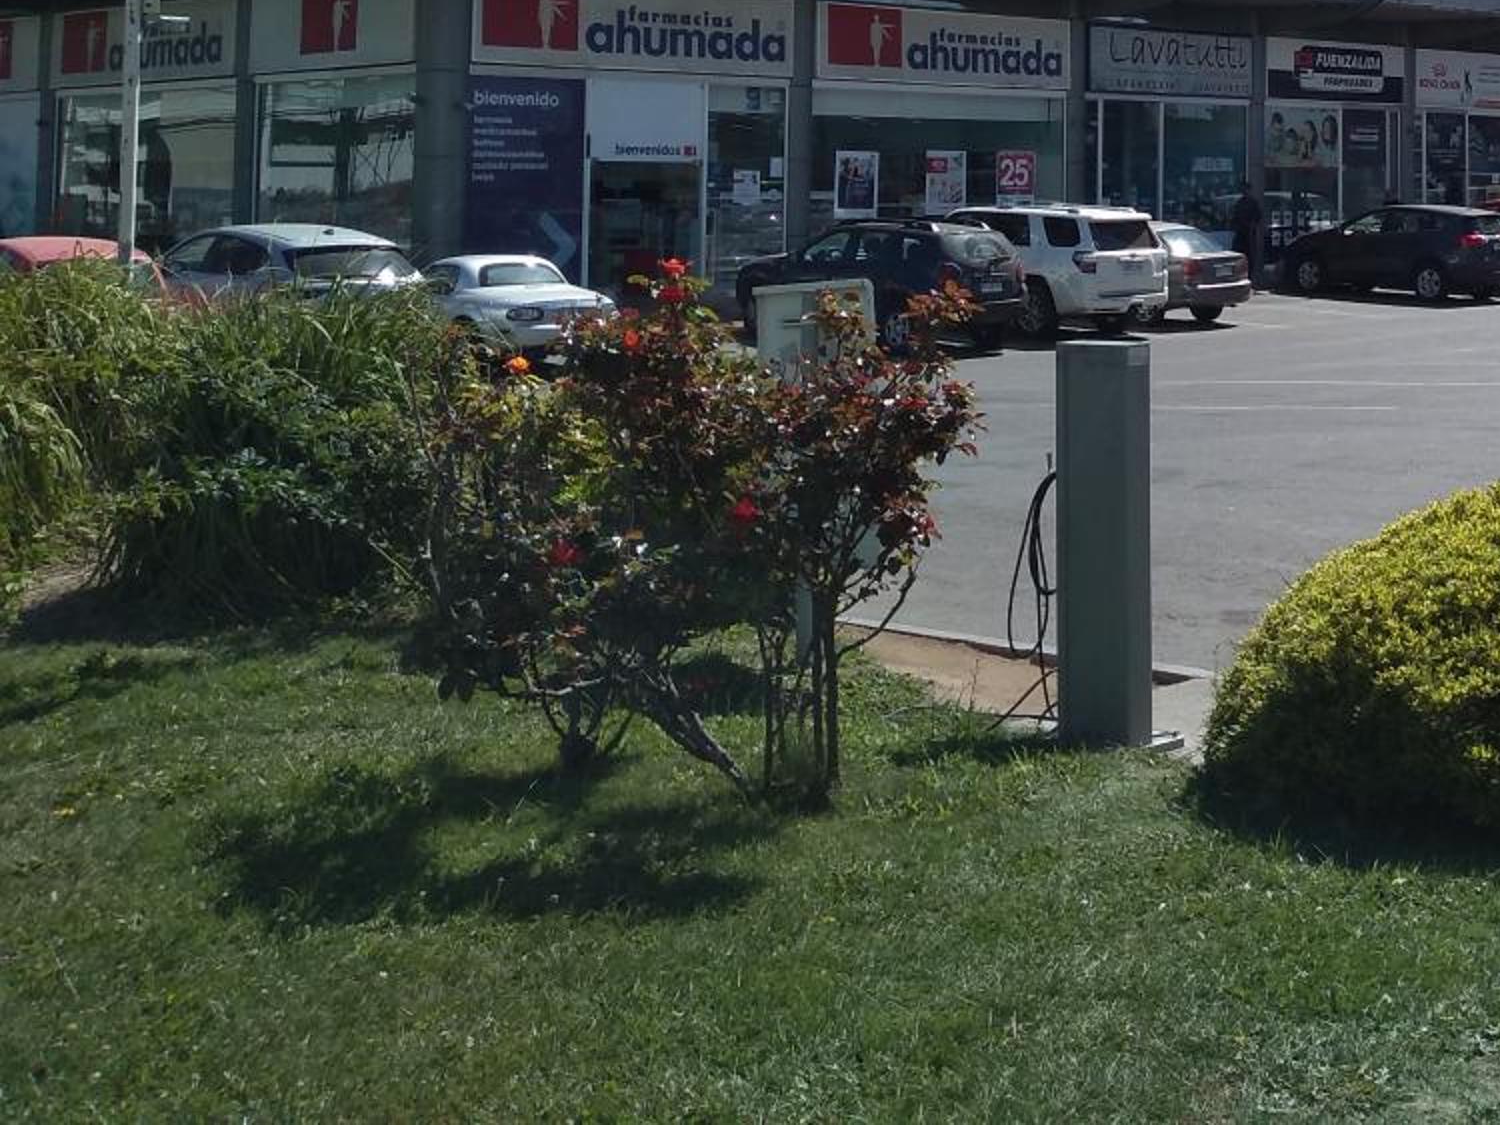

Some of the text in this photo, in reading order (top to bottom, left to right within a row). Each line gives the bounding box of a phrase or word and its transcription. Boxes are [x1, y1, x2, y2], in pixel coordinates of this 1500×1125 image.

[628, 6, 734, 28] farmacias
[109, 21, 223, 71] aumada
[585, 10, 786, 62] ahumada
[938, 27, 1021, 47] farmacias
[907, 31, 1063, 77] ahumada
[473, 90, 560, 108] bienvenido
